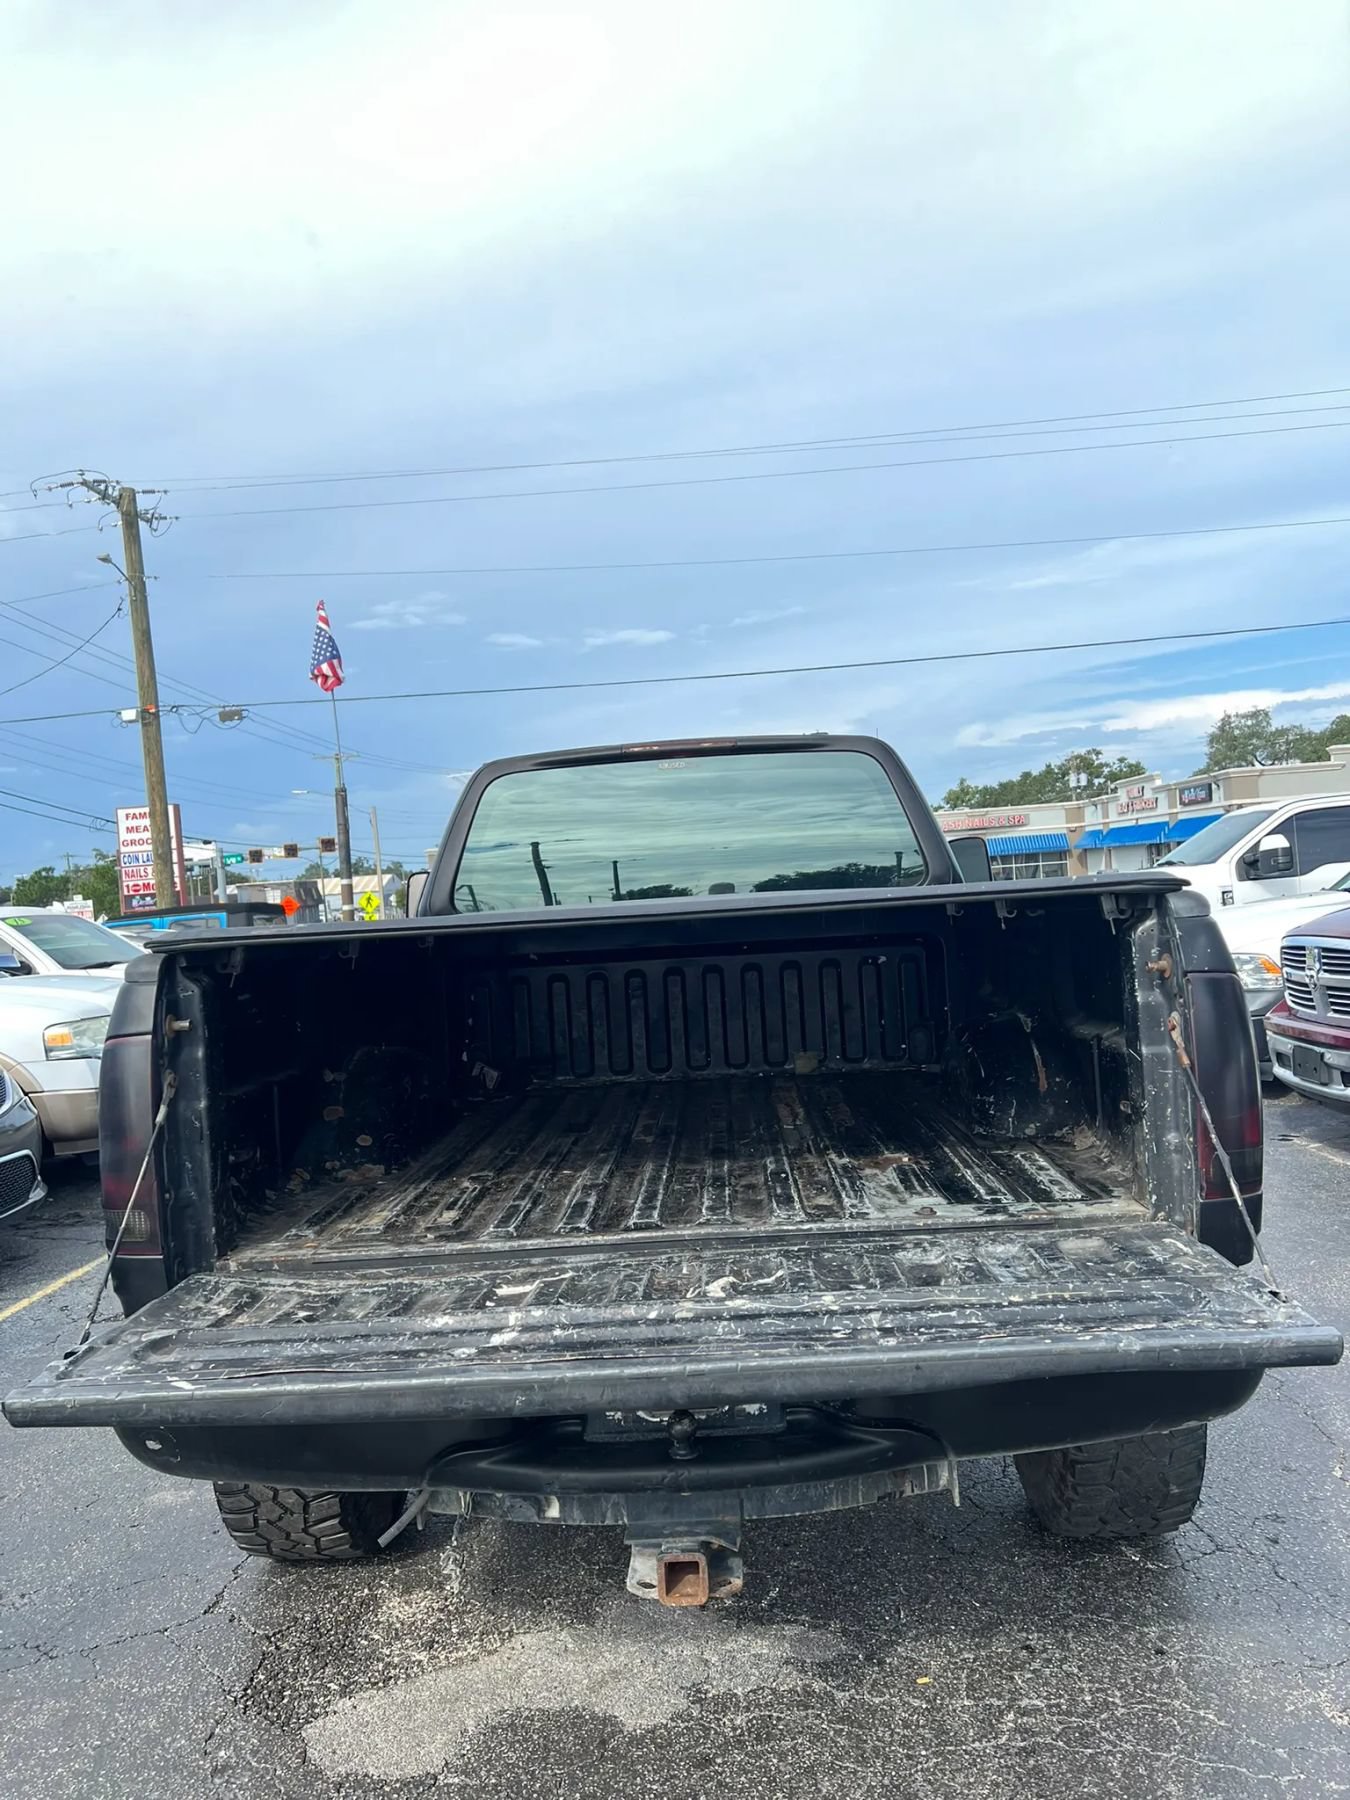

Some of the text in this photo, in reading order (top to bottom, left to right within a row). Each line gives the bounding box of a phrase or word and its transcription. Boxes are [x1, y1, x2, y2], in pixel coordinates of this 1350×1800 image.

[1008, 814, 1025, 825] SPA
[122, 854, 140, 865] COIN
[124, 867, 149, 879] NAILS
